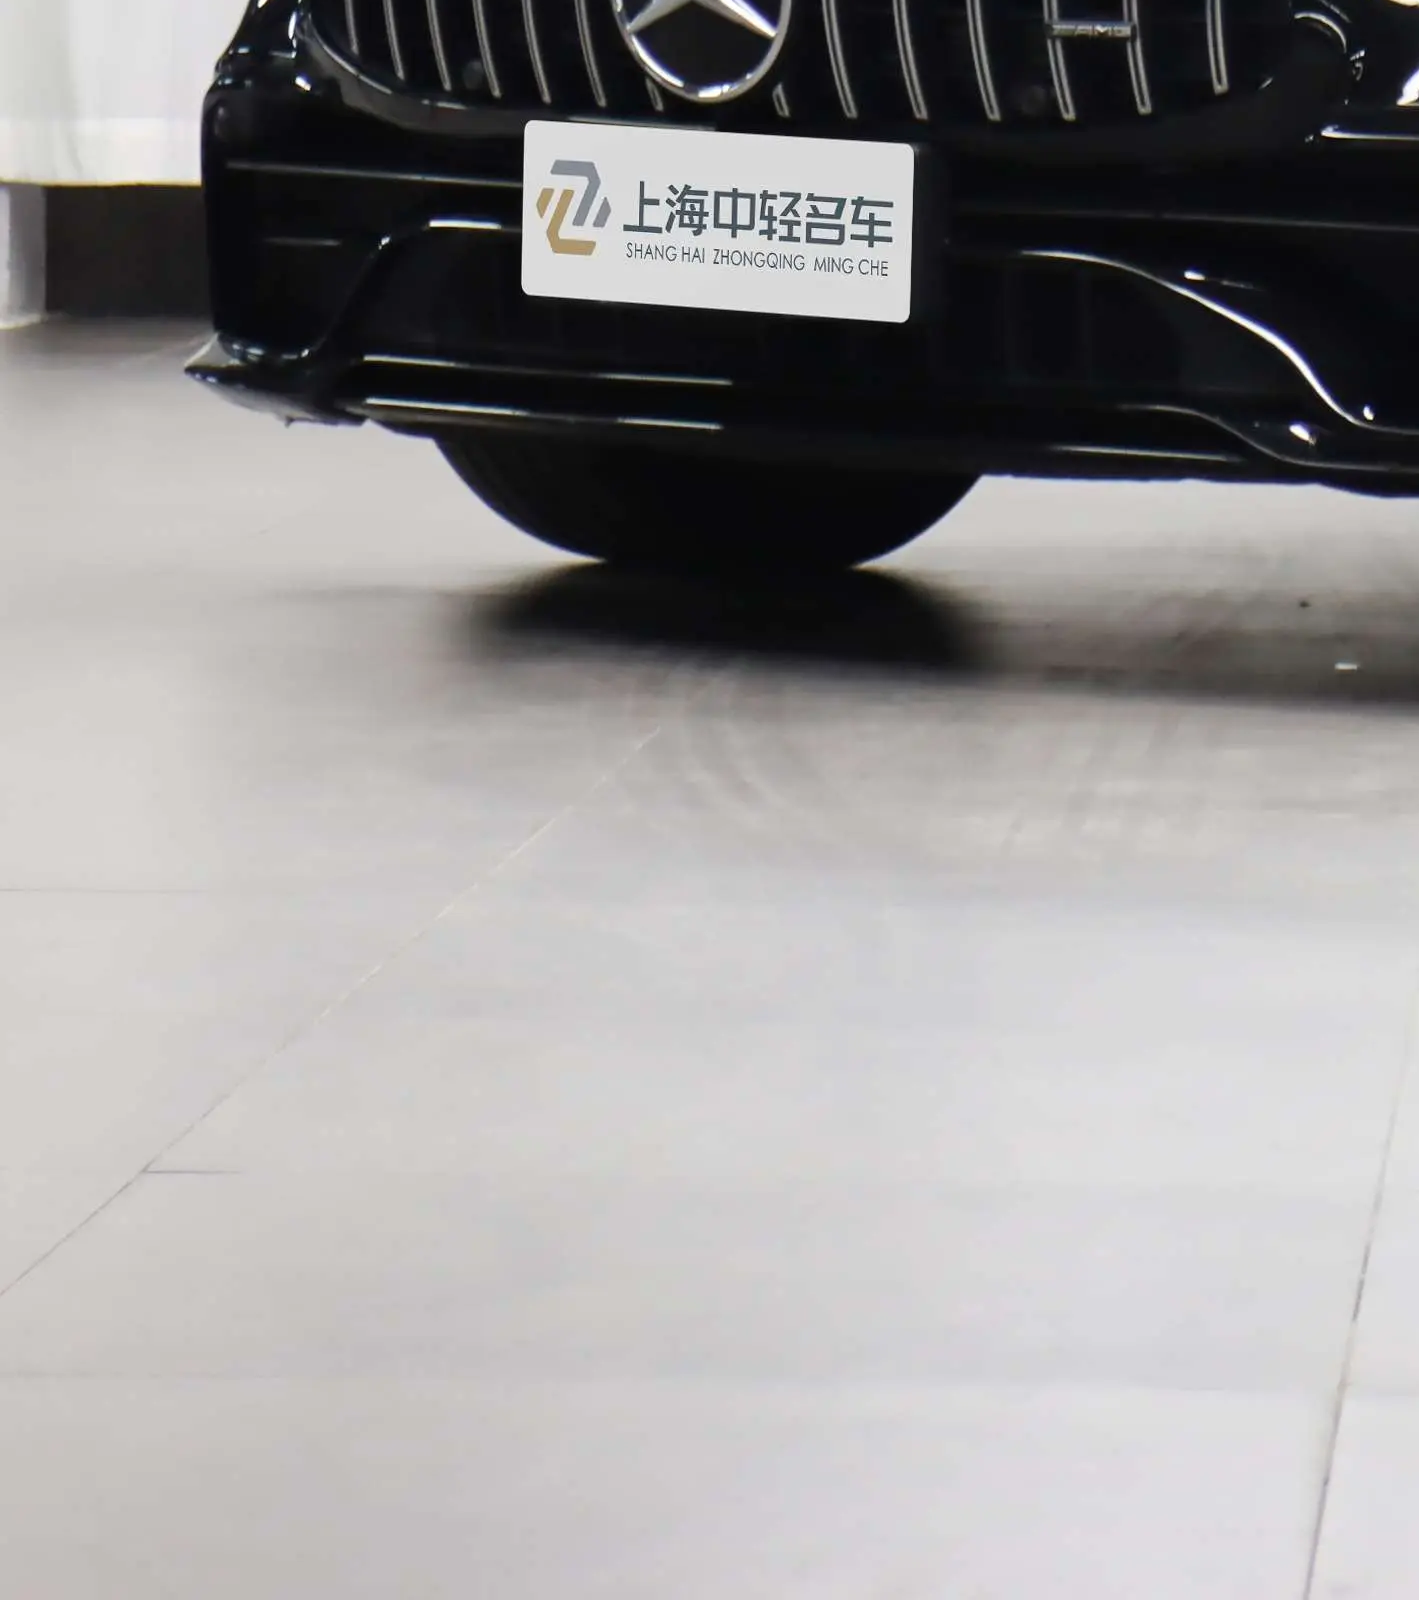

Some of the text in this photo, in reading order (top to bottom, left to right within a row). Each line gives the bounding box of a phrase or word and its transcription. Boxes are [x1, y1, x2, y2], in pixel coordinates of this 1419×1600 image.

[622, 180, 894, 249] 上海中轻名车
[625, 241, 890, 277] SHANG HAI ZHONGQING MING CHE
